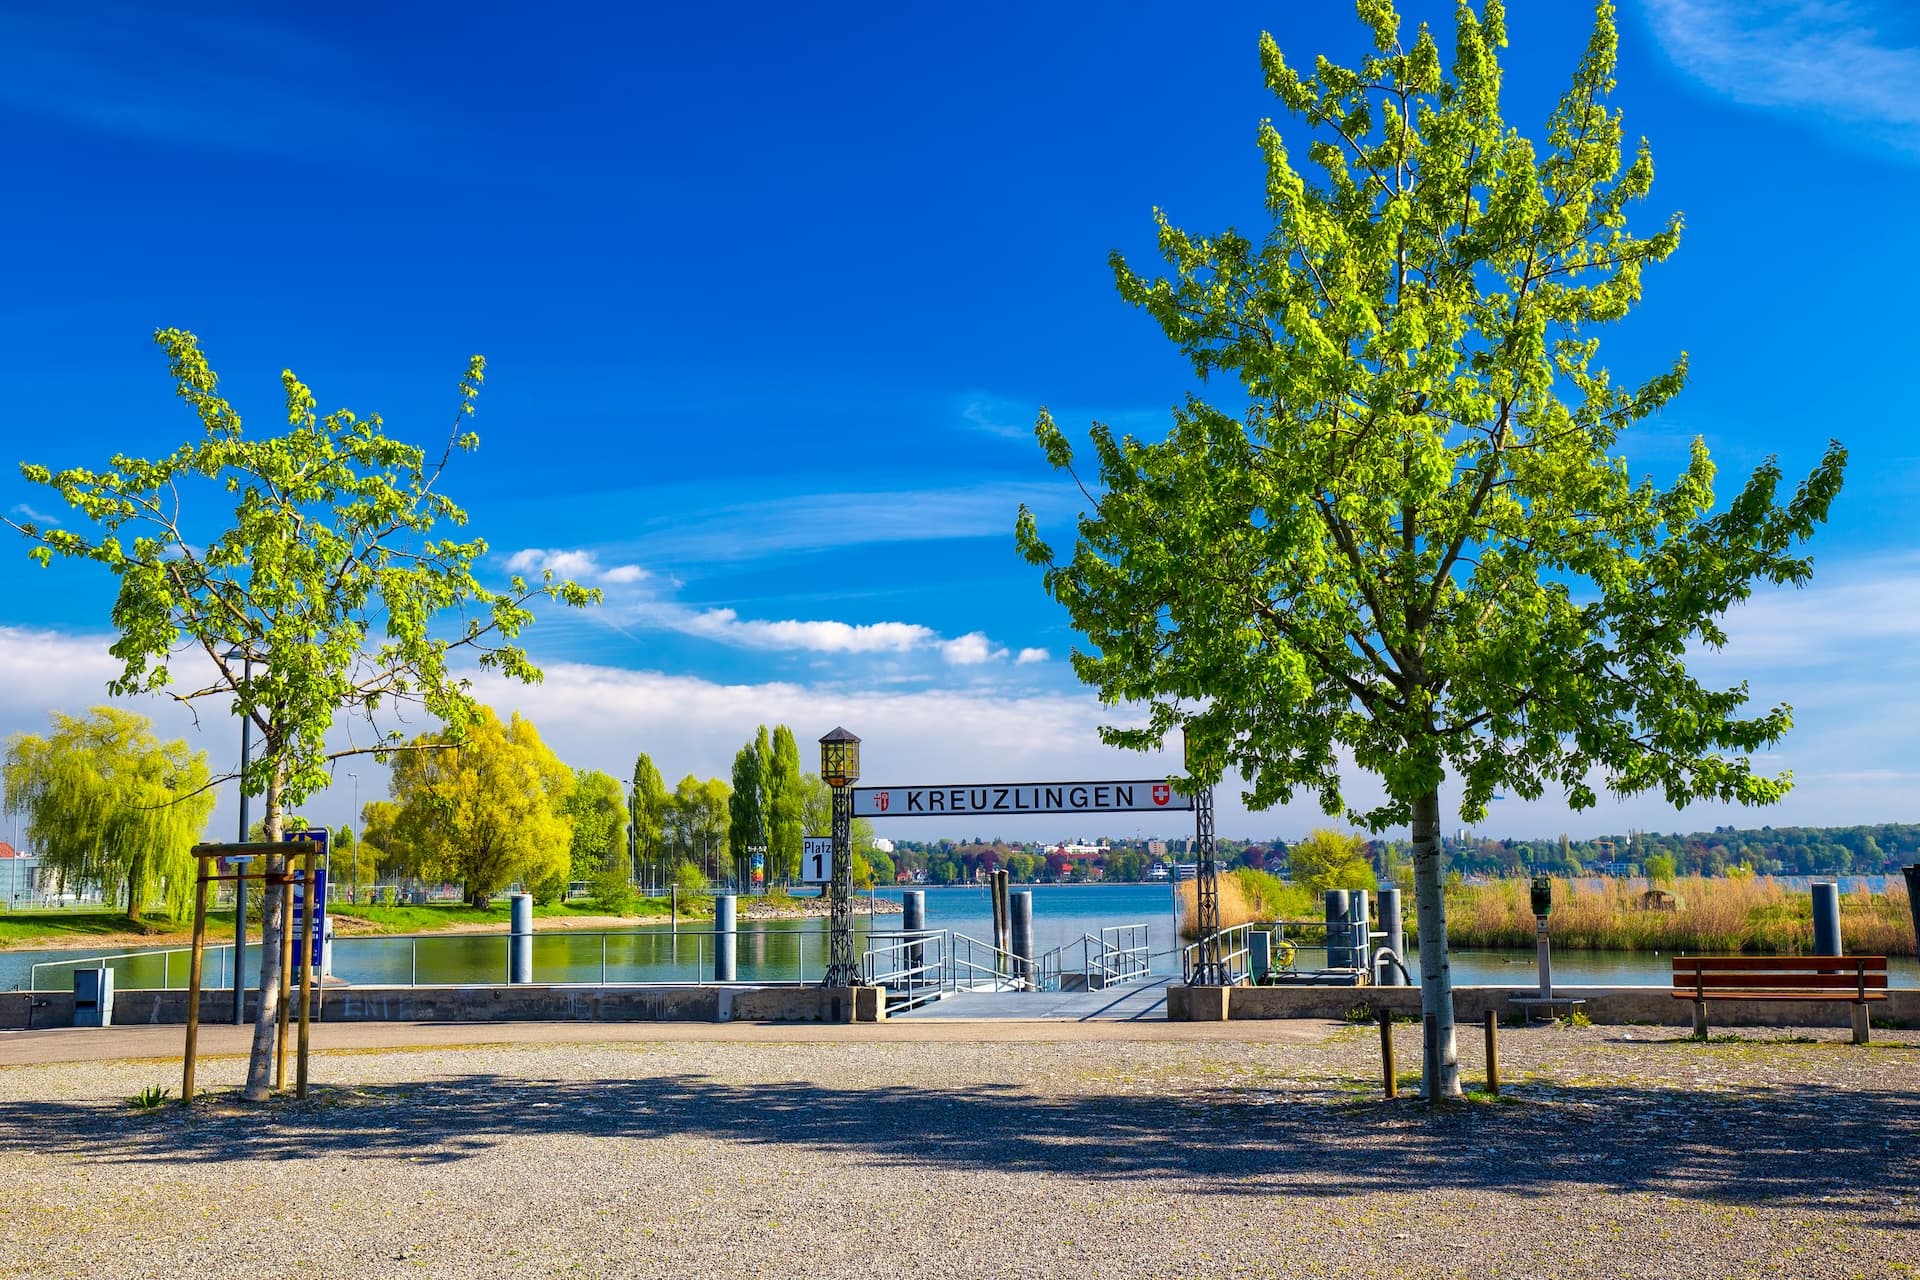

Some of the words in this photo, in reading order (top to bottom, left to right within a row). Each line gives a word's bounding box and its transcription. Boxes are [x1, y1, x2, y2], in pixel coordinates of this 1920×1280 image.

[907, 785, 1133, 811] KREUZLINGEN
[804, 841, 831, 854] Platz
[812, 853, 823, 879] 1
